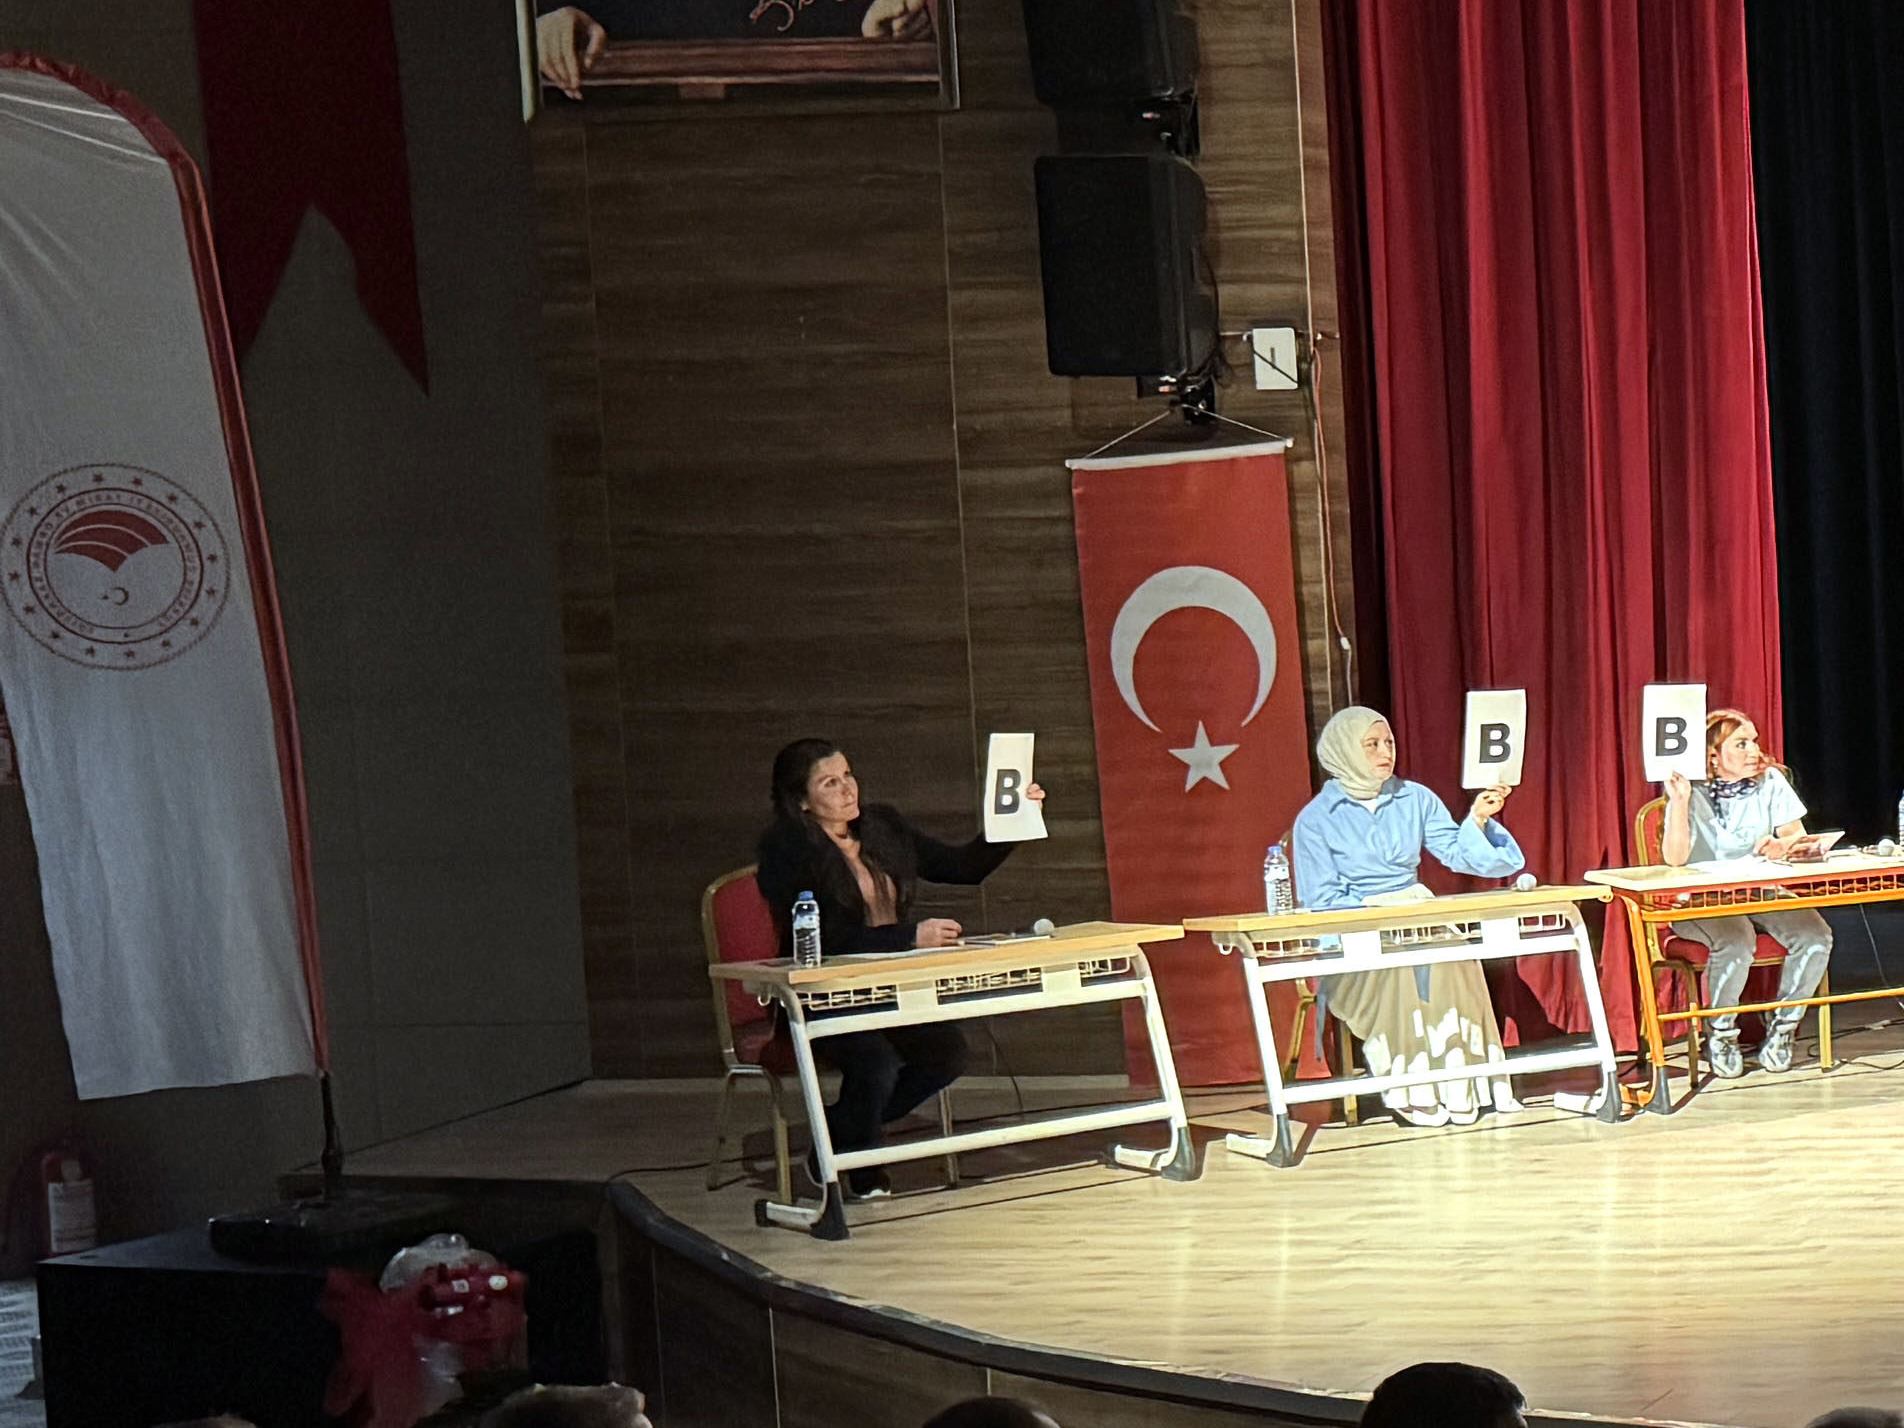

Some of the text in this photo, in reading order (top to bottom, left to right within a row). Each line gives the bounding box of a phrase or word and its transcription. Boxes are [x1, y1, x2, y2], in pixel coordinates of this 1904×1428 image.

[1480, 723, 1511, 763] B
[1656, 717, 1688, 756] B
[995, 769, 1021, 814] B
